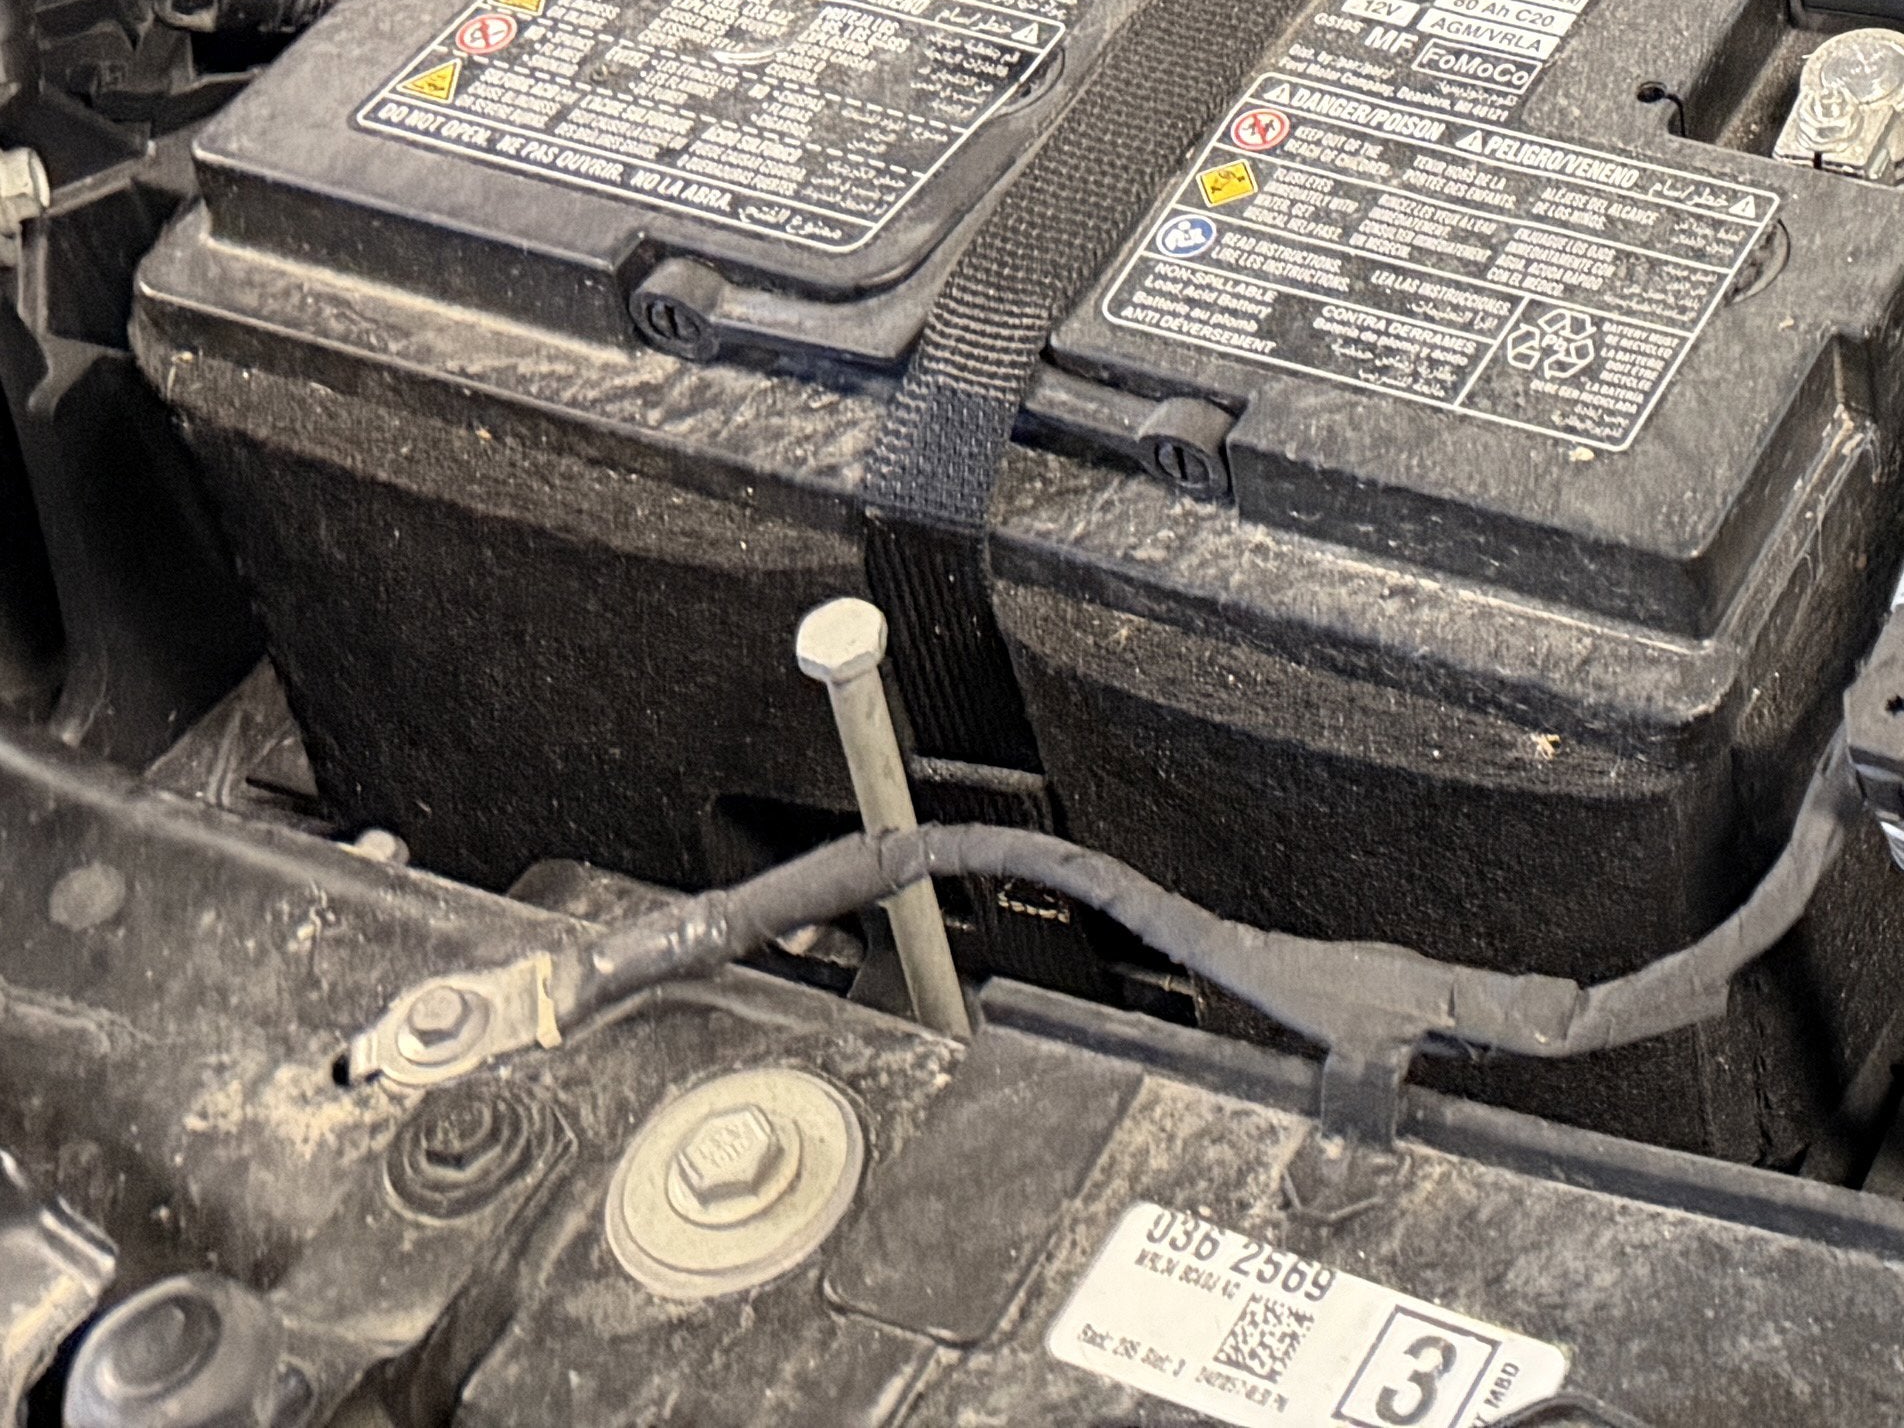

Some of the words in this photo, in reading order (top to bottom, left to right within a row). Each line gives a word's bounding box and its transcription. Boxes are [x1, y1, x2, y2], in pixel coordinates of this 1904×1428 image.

[1430, 14, 1544, 55] AGM/VRLA
[1482, 1, 1511, 18] Ah
[1514, 8, 1555, 28] C20
[1362, 26, 1419, 55] MF
[1420, 43, 1532, 91] FoMoCo
[374, 103, 412, 123] DO
[400, 111, 447, 132] NOT
[436, 120, 498, 147] OPEN.
[1289, 88, 1446, 140] DANGER/POISON
[1481, 136, 1640, 189] PELIGRO/VENENO
[493, 135, 528, 154] NE
[517, 141, 561, 163] PAS
[550, 150, 630, 182] OUVRIR.
[627, 171, 662, 190] NO
[652, 177, 686, 197] LA
[676, 185, 740, 211] ABRA.
[1153, 262, 1279, 302] NON-SPILLABLE
[1120, 304, 1162, 323] ANTI
[1158, 314, 1277, 354] DÉVERSEMENT
[1320, 305, 1389, 330] CONTRA
[1387, 322, 1478, 353] DERRAMES
[1540, 333, 1570, 352] Pb
[1144, 1206, 1220, 1261] 036
[1230, 1234, 1337, 1302] 2569
[1374, 1334, 1459, 1427] 3
